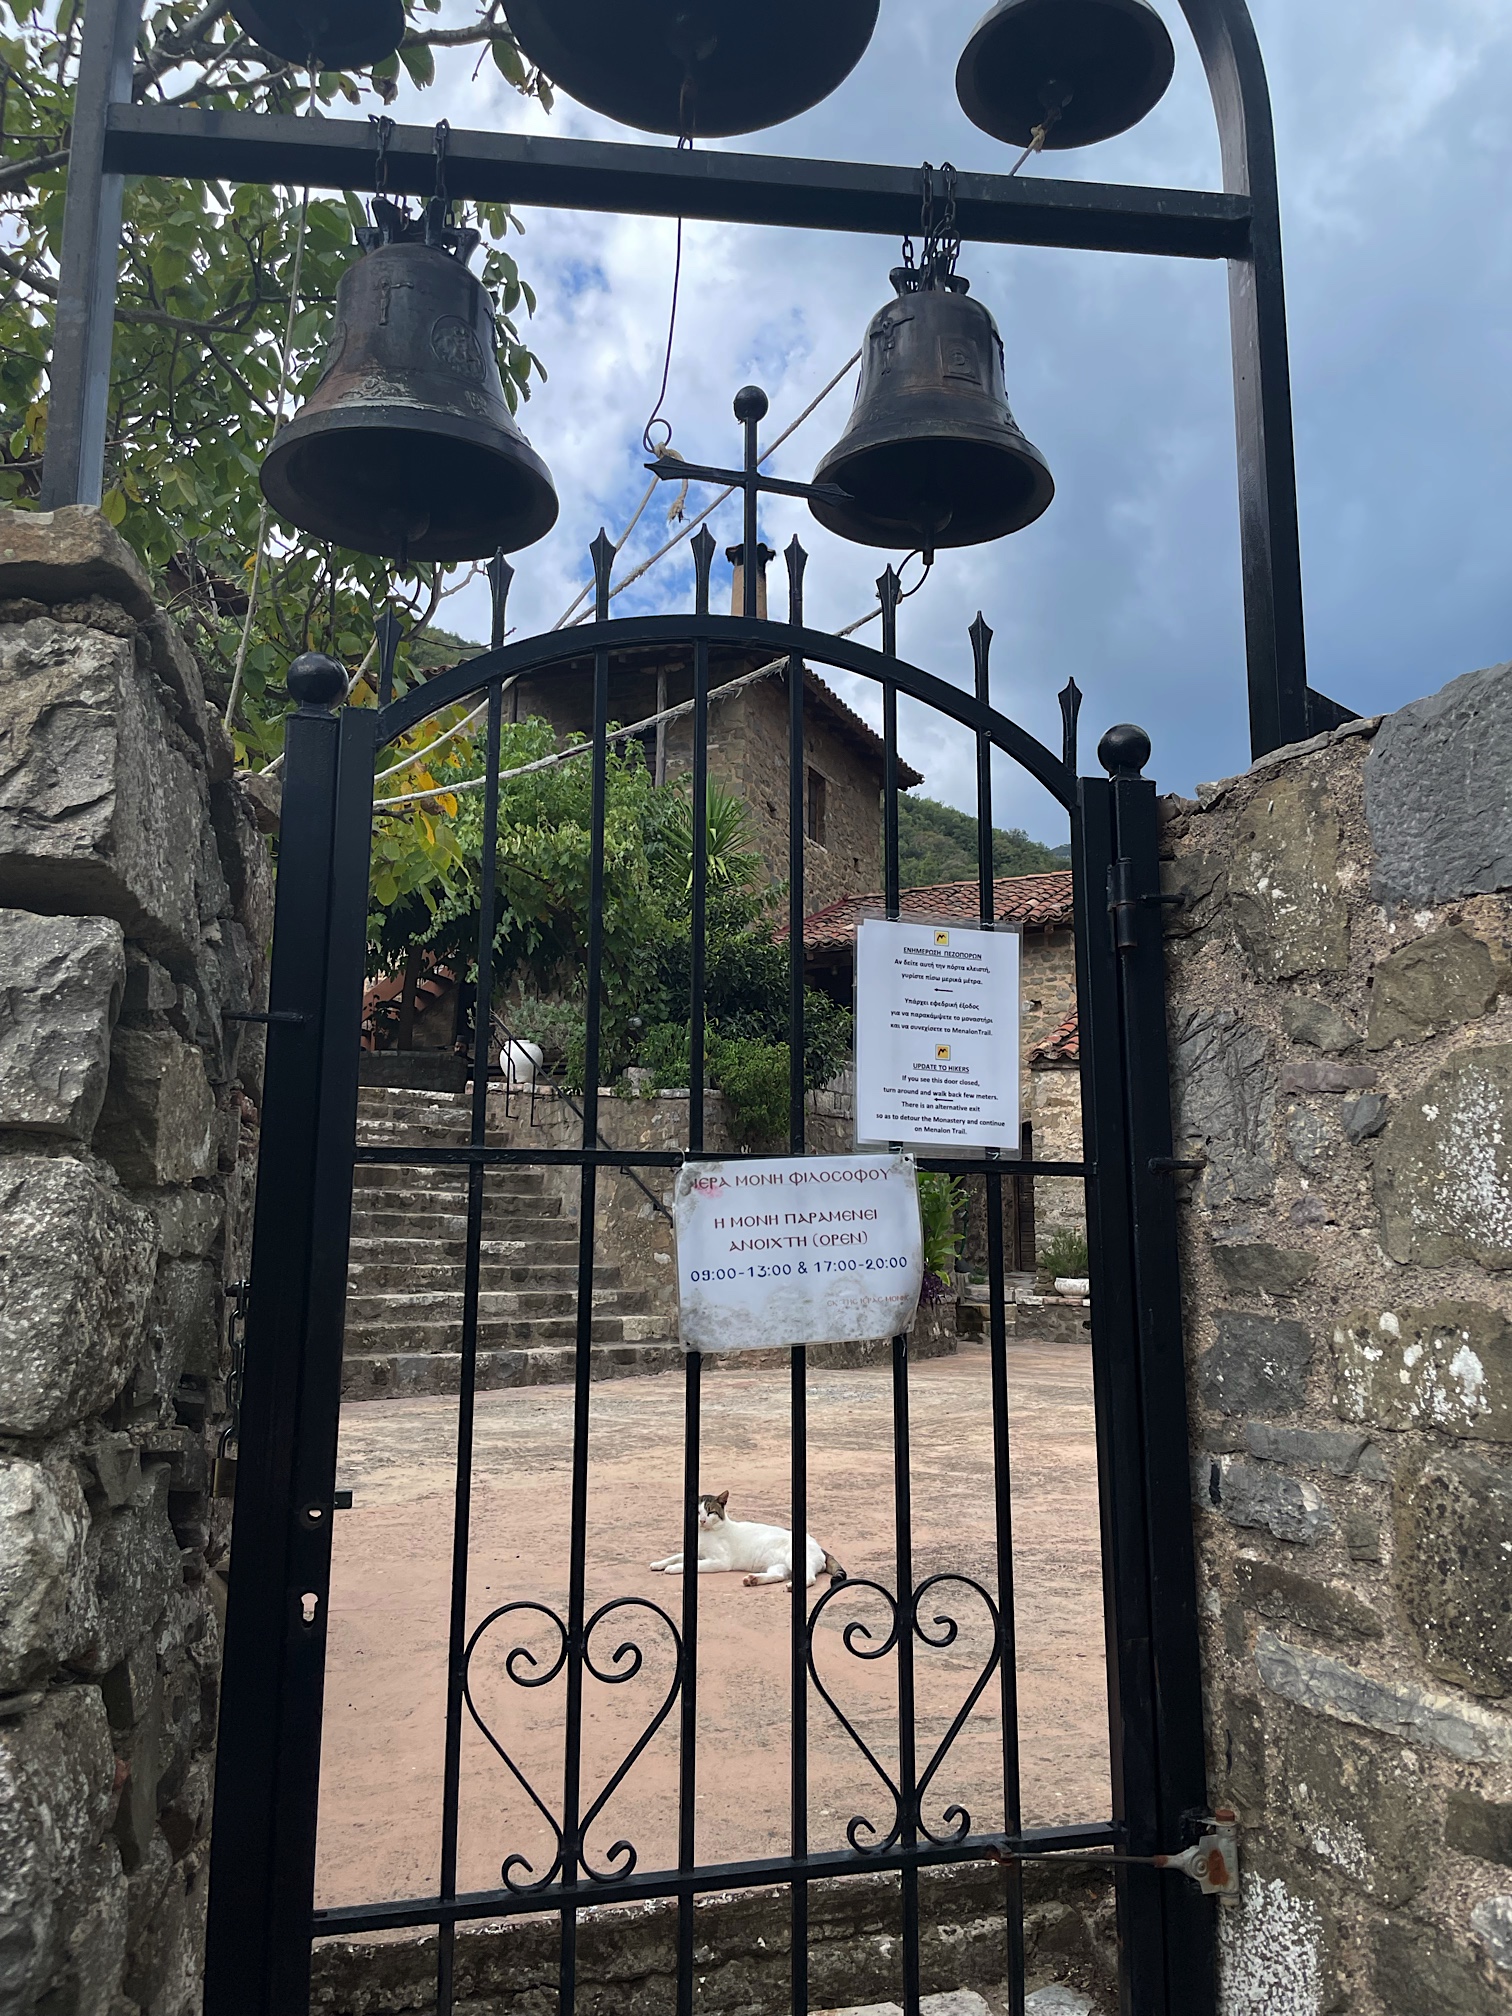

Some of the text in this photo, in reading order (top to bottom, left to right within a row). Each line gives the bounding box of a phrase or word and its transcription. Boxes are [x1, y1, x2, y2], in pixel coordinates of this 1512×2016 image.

[903, 947, 982, 959] ΕΝΗΜΕΡΩΣΗ ΠΕΖΟΠΟΡΩΝ
[904, 998, 929, 1006] Υπάρχει
[913, 1063, 937, 1071] UPDATE
[948, 1065, 970, 1073] HIKERS
[959, 1079, 980, 1087] closed,
[897, 1088, 918, 1096] around
[935, 1103, 968, 1111] alternative
[900, 1114, 921, 1122] detour
[933, 1116, 966, 1125] Monastery
[979, 1119, 1005, 1127] continue
[924, 1126, 951, 1134] Menalon
[952, 1127, 968, 1135] Trail.
[736, 1174, 783, 1186] ΜΟΝΗ
[731, 1214, 779, 1228] ΜΟΝΗ
[785, 1209, 878, 1225] ΠΑΡΑΜΕΝΕΙ
[729, 1236, 807, 1252] ΑΝΟΙΧΤΗ
[691, 1257, 907, 1282] 09:00-13:00 & 17:00-20:00
